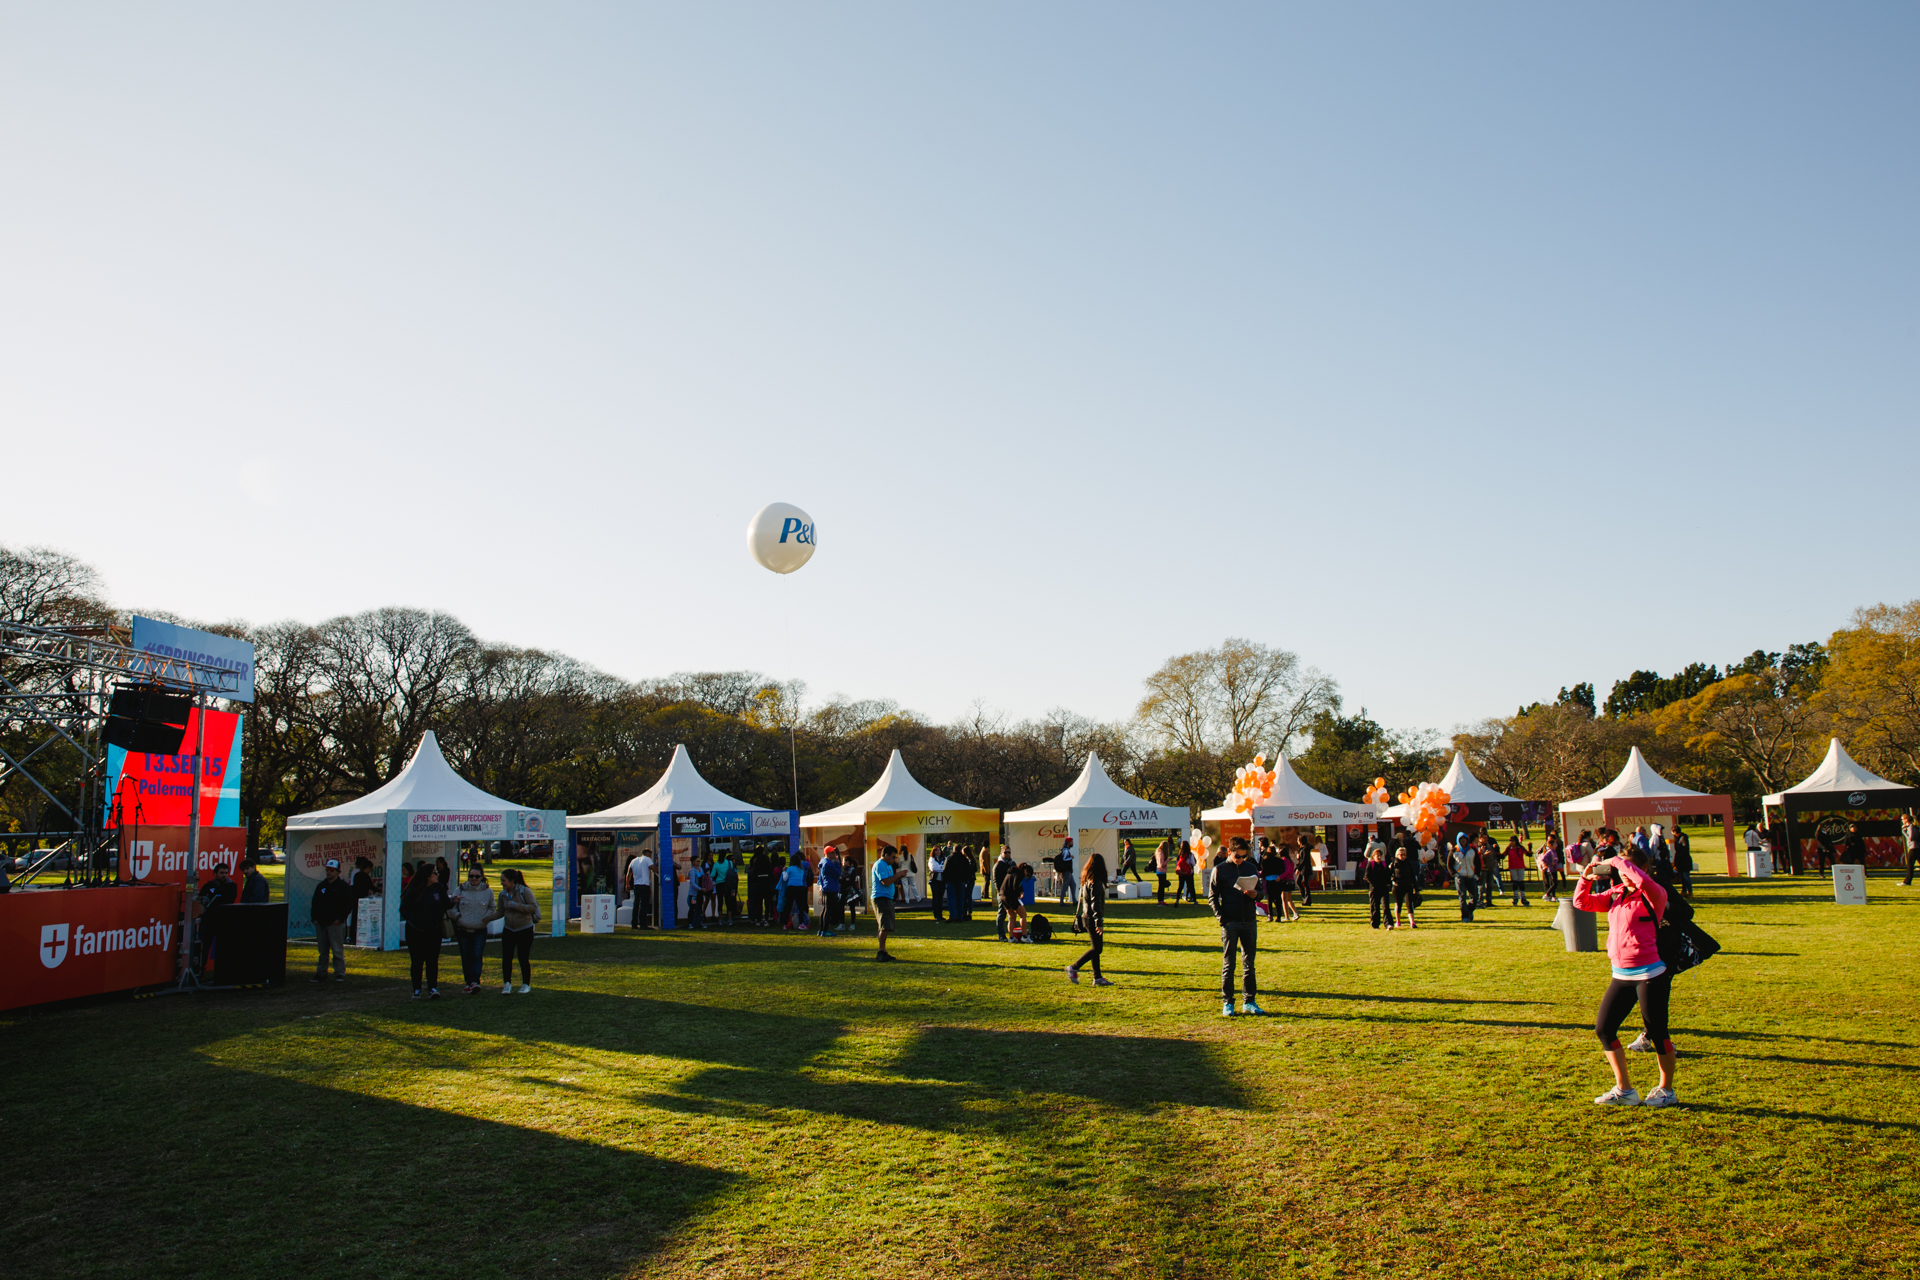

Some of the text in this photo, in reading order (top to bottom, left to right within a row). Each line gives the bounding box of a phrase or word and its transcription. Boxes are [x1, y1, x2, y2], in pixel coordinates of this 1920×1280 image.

[1655, 804, 1681, 813] Avène
[412, 814, 503, 824] ¿PIEL CON IMPERFECCIONES?
[675, 816, 697, 824] Gillette
[1287, 811, 1333, 821] #SoyDeDia
[1342, 810, 1374, 820] Daylong
[717, 816, 747, 831] Venus
[755, 816, 788, 828] Old Spice
[916, 815, 952, 826] VICHY
[1578, 818, 1598, 827] EAU
[412, 822, 502, 832] DESCUBRÍ LA NUEVA RUTINA PURE
[620, 832, 639, 842] Venus
[314, 839, 367, 852] TE MAQUILLASTE
[305, 853, 322, 861] PARA
[323, 849, 342, 859] VENIR
[349, 845, 377, 855] ROLLEAR
[306, 860, 321, 868] CON
[346, 852, 377, 863] PERCTA
[73, 918, 173, 956] farmacity
